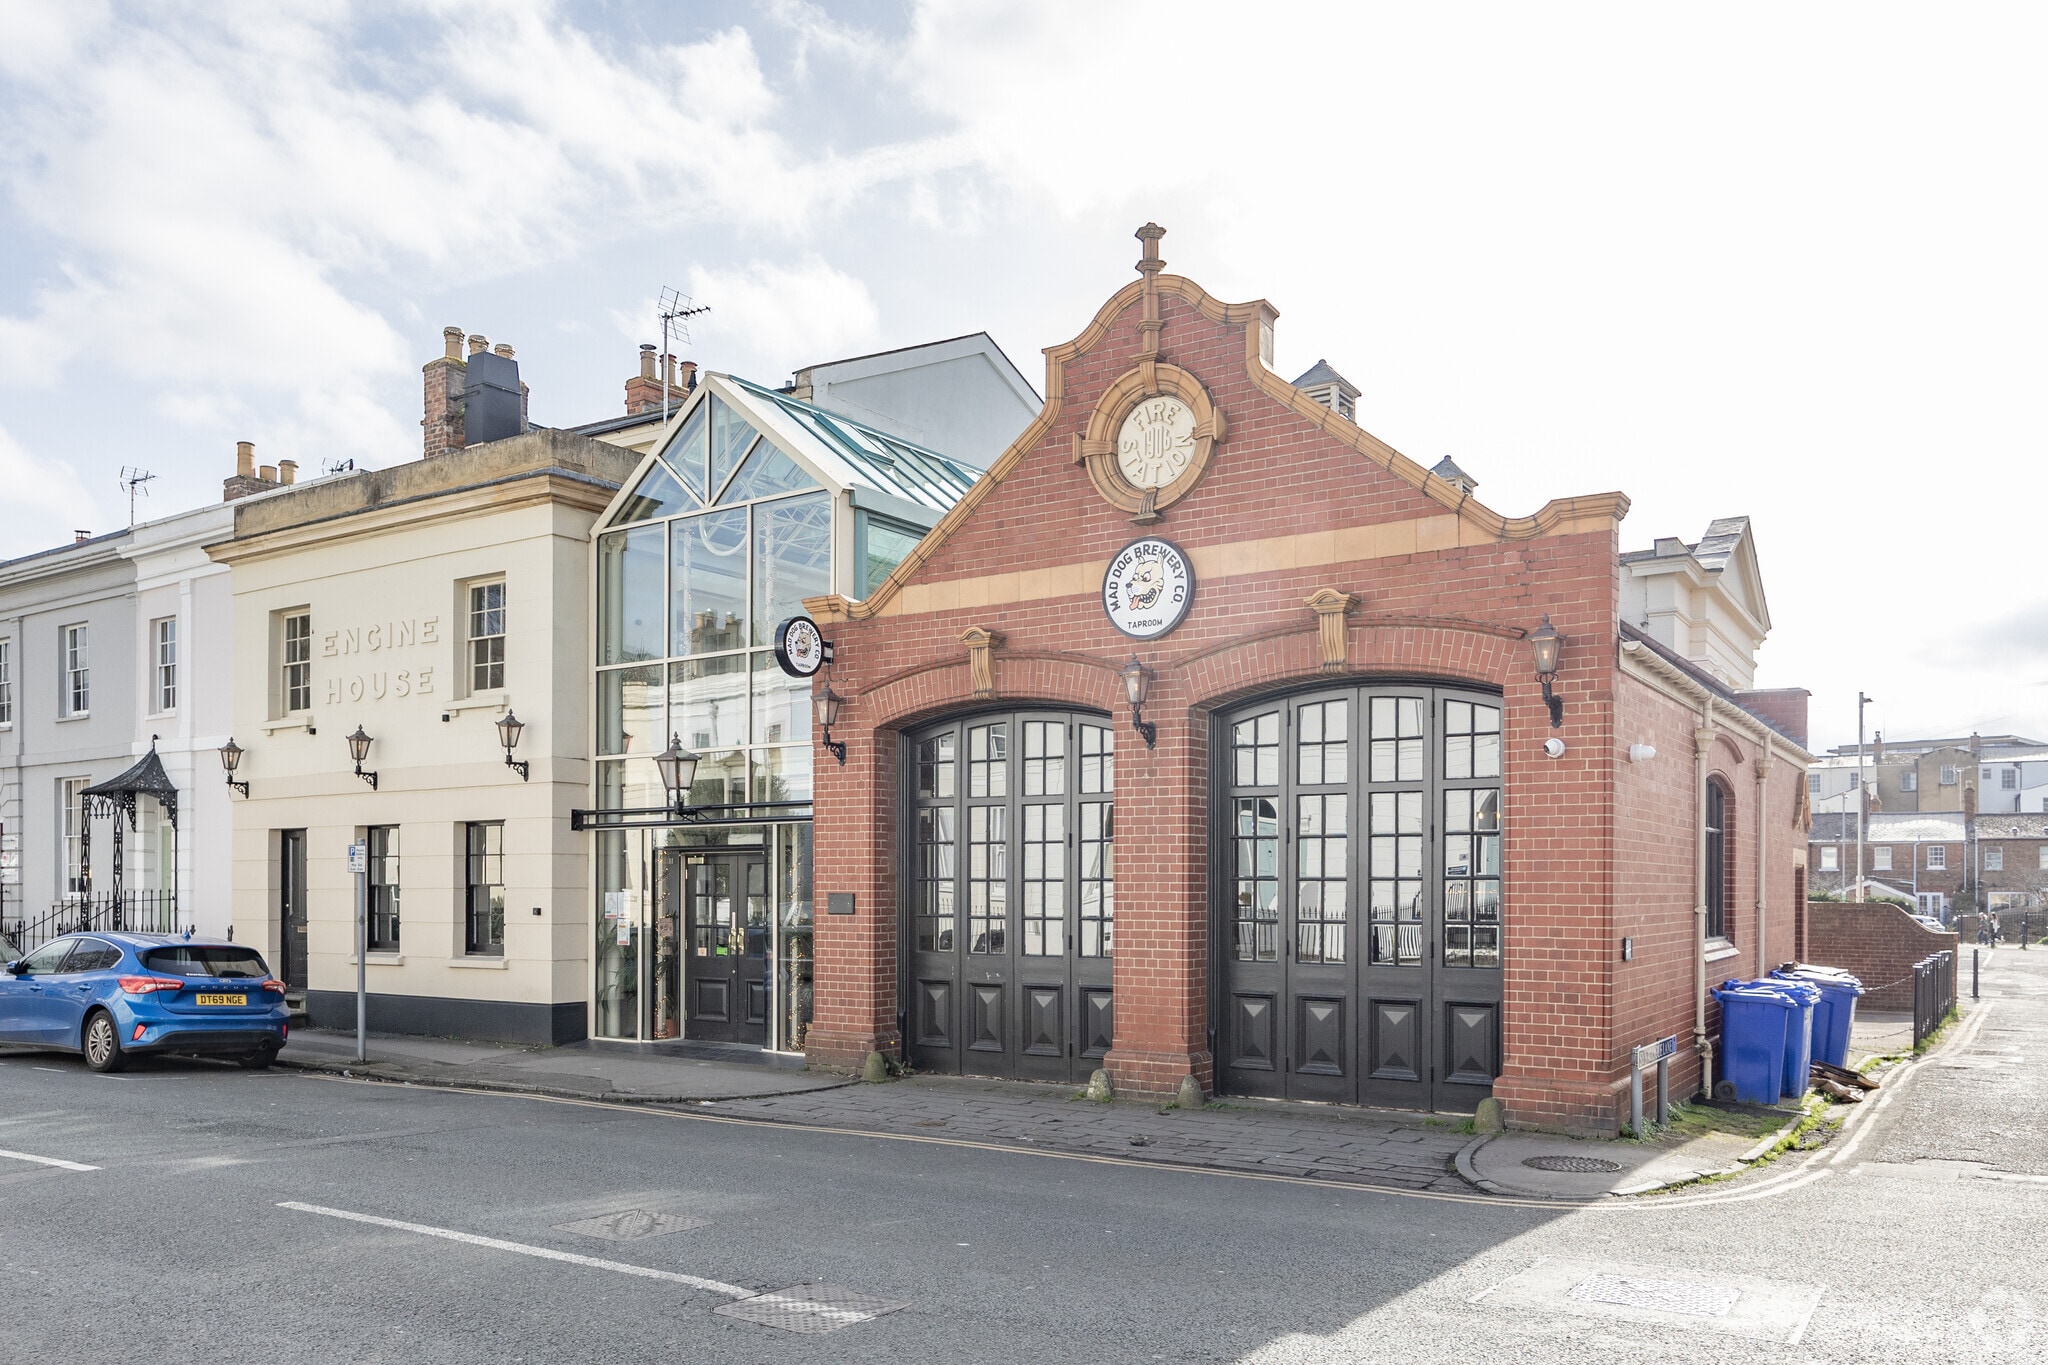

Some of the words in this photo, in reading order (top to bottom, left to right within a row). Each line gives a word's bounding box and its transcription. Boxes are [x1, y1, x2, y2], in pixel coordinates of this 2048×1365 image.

[1132, 401, 1181, 431] FIRE
[1120, 432, 1193, 483] STATION
[1143, 425, 1172, 459] 1906
[1112, 553, 1133, 578] DOG
[1134, 544, 1185, 579] BREWERY
[1108, 581, 1121, 612] MAD
[322, 615, 439, 658] ENGINE
[789, 625, 799, 637] DOG
[799, 622, 820, 648] BREWERY
[1128, 618, 1163, 629] TAPROOM
[326, 666, 434, 705] HOUSE
[200, 995, 224, 1004] DT69
[226, 995, 243, 1004] NGE
